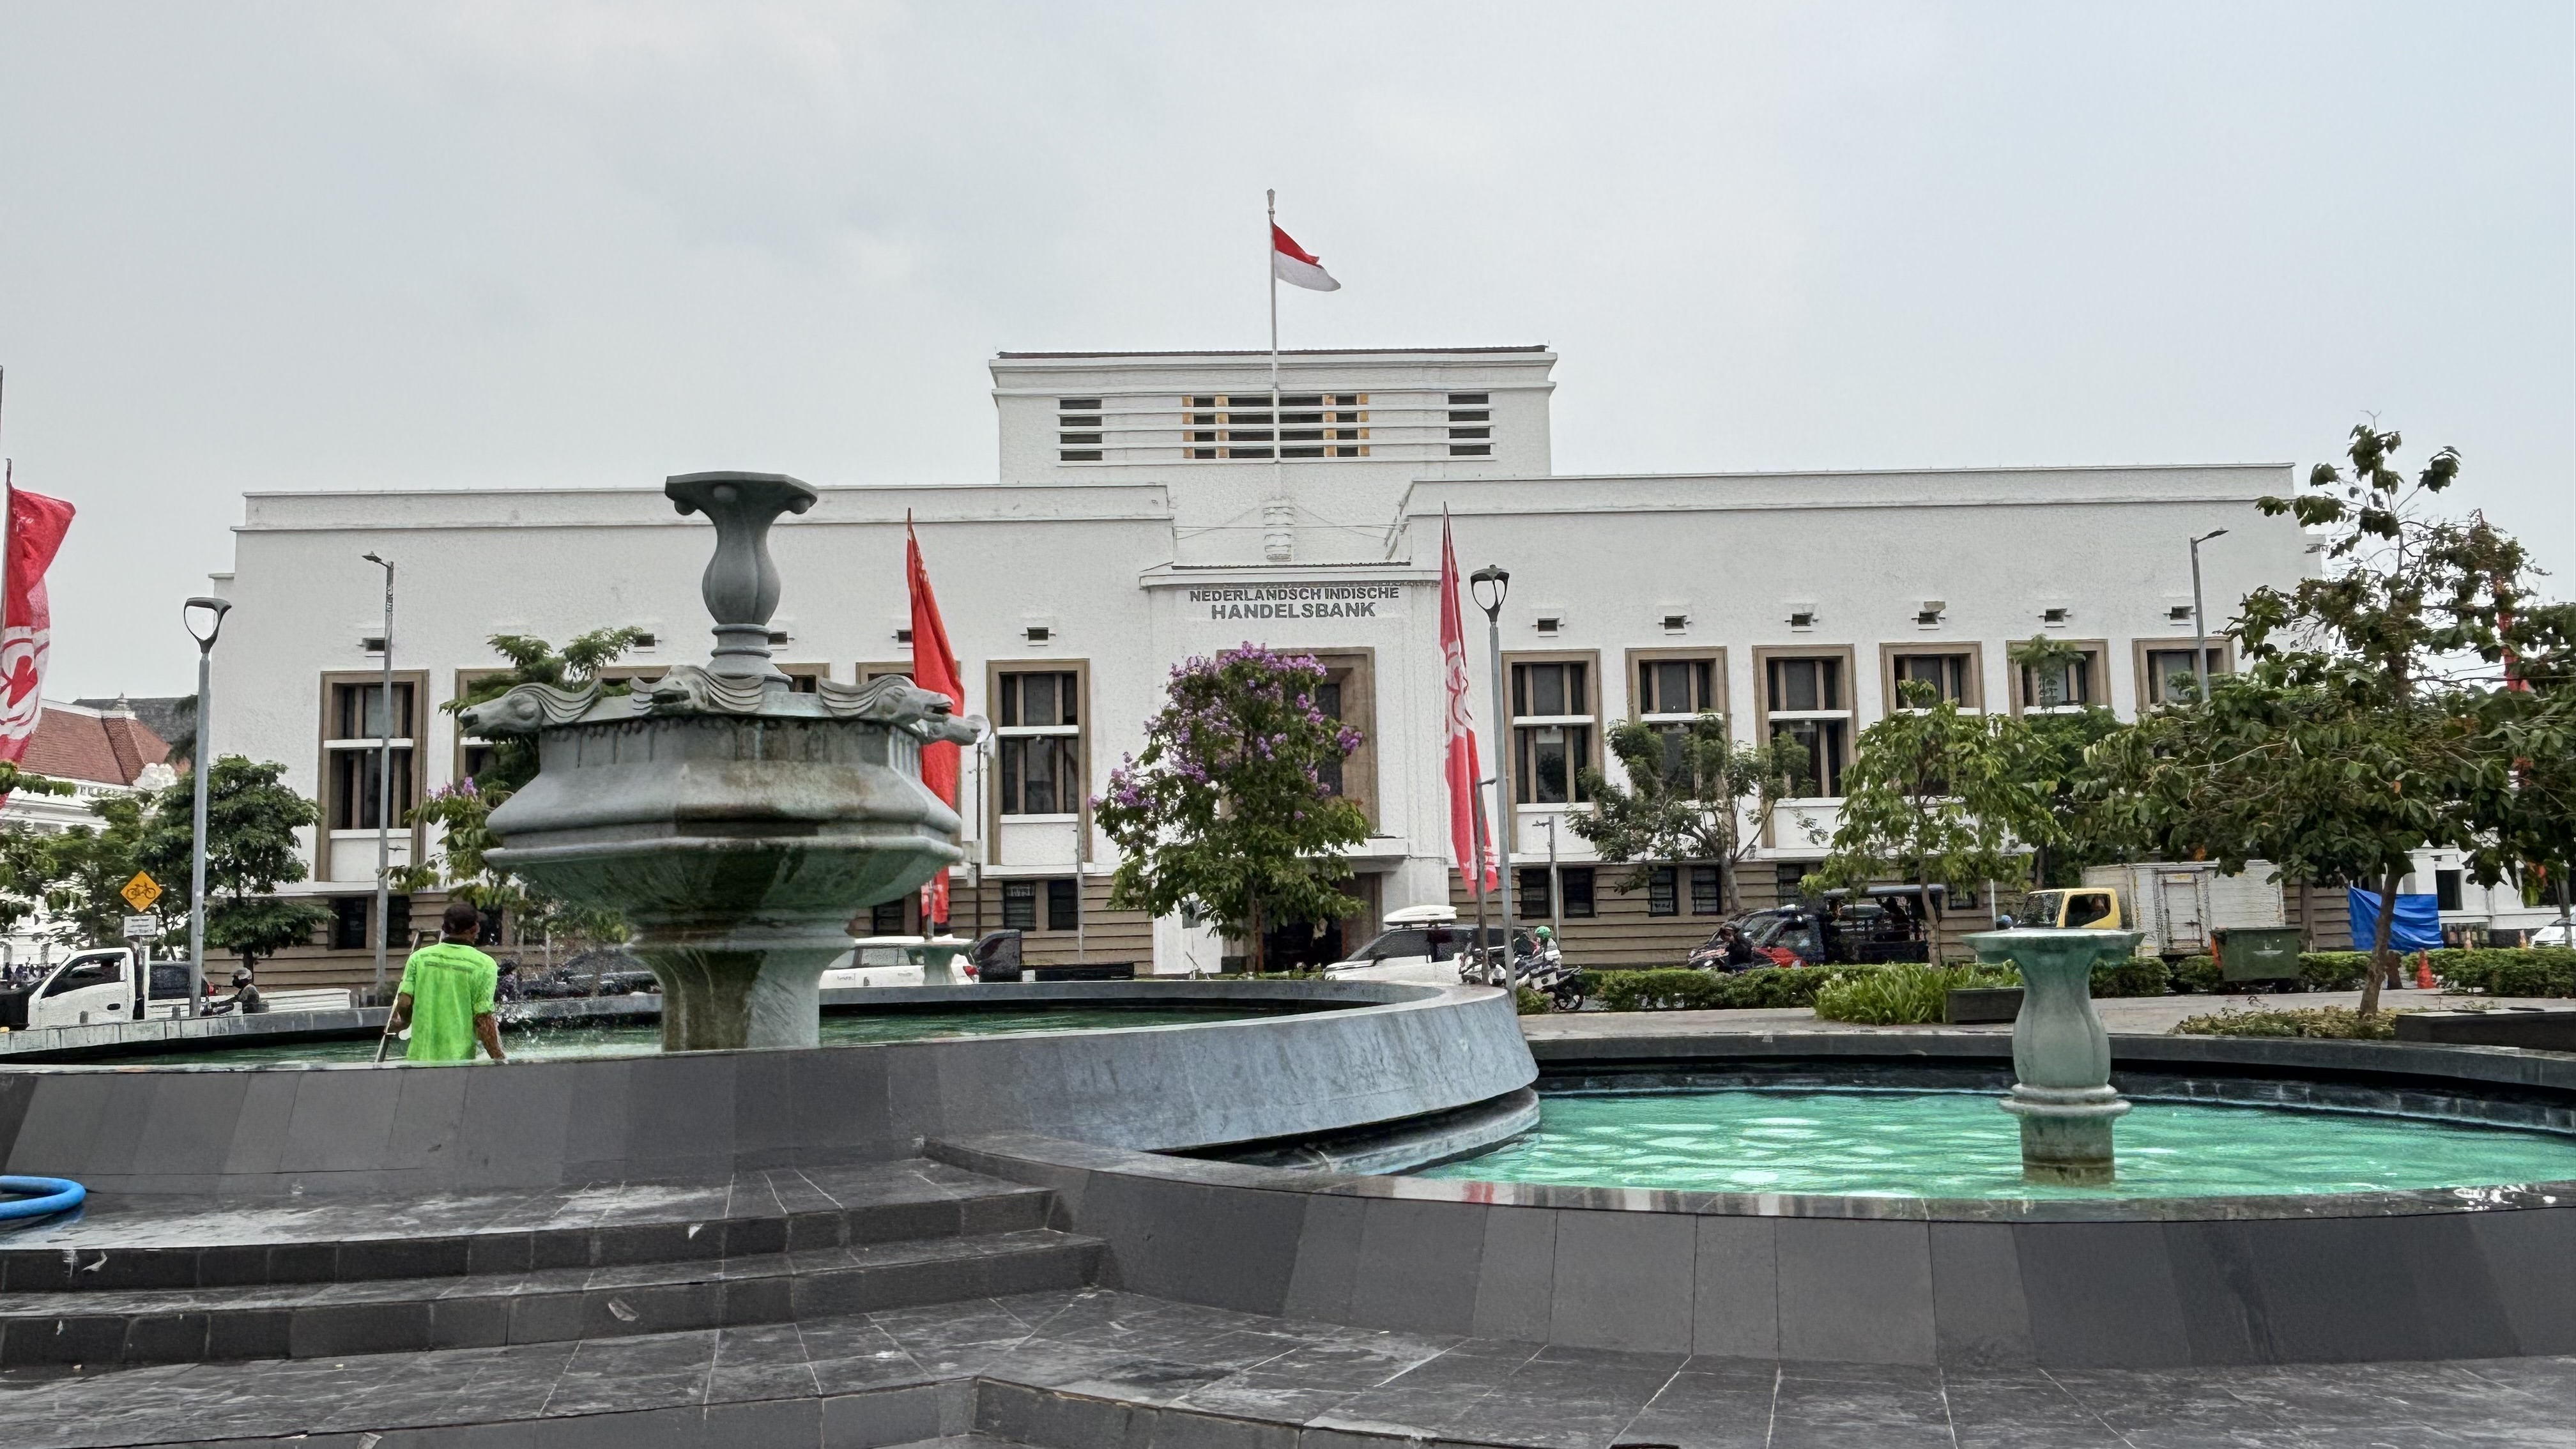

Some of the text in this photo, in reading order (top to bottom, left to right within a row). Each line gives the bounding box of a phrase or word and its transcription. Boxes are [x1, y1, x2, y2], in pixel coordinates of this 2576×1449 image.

[1190, 587, 1399, 602] NEDERLANDSCH INDISCHE
[1211, 602, 1376, 619] HANDELSBANK
